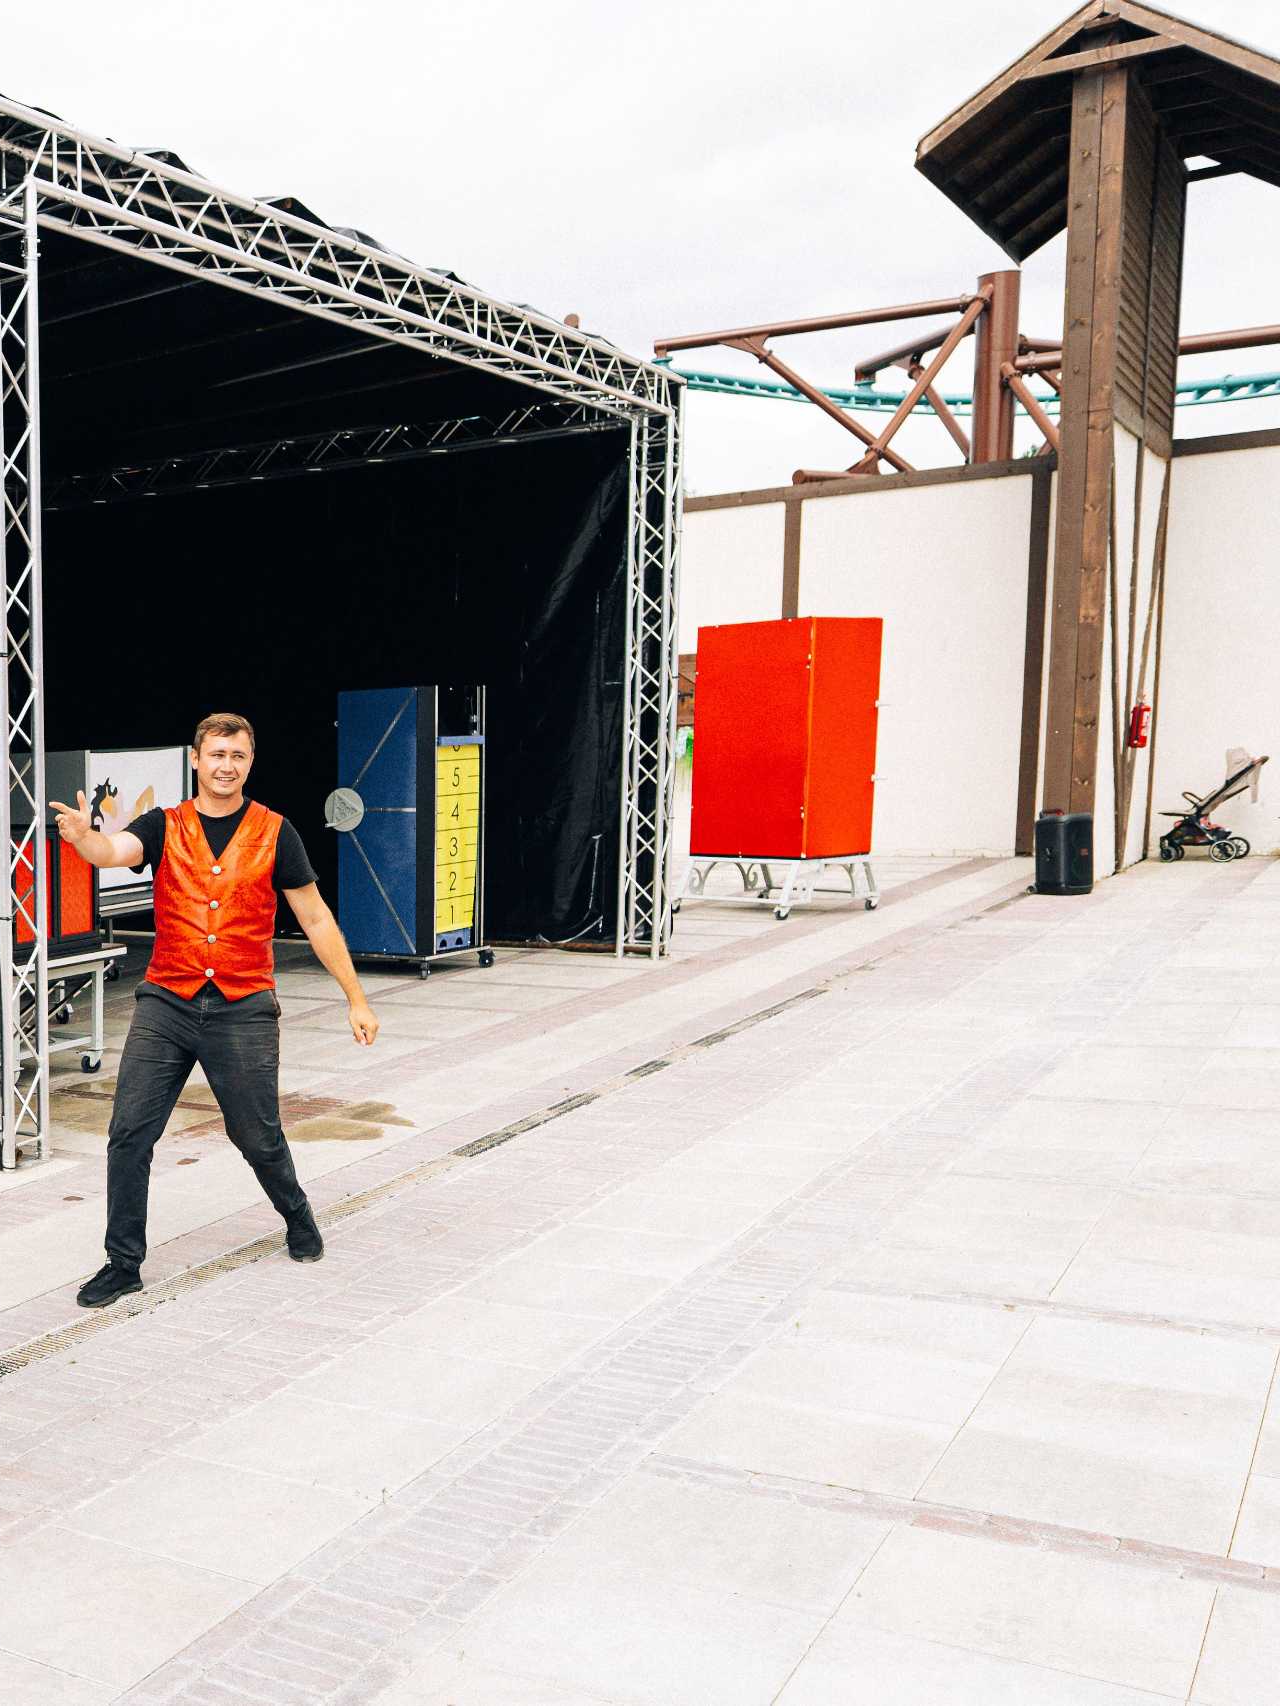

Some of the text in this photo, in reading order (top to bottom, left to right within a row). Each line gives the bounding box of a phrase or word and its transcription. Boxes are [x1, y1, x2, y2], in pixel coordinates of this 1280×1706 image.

[452, 767, 460, 787] 5
[451, 801, 460, 822] 4
[449, 836, 458, 857] 3
[449, 871, 457, 891] 2
